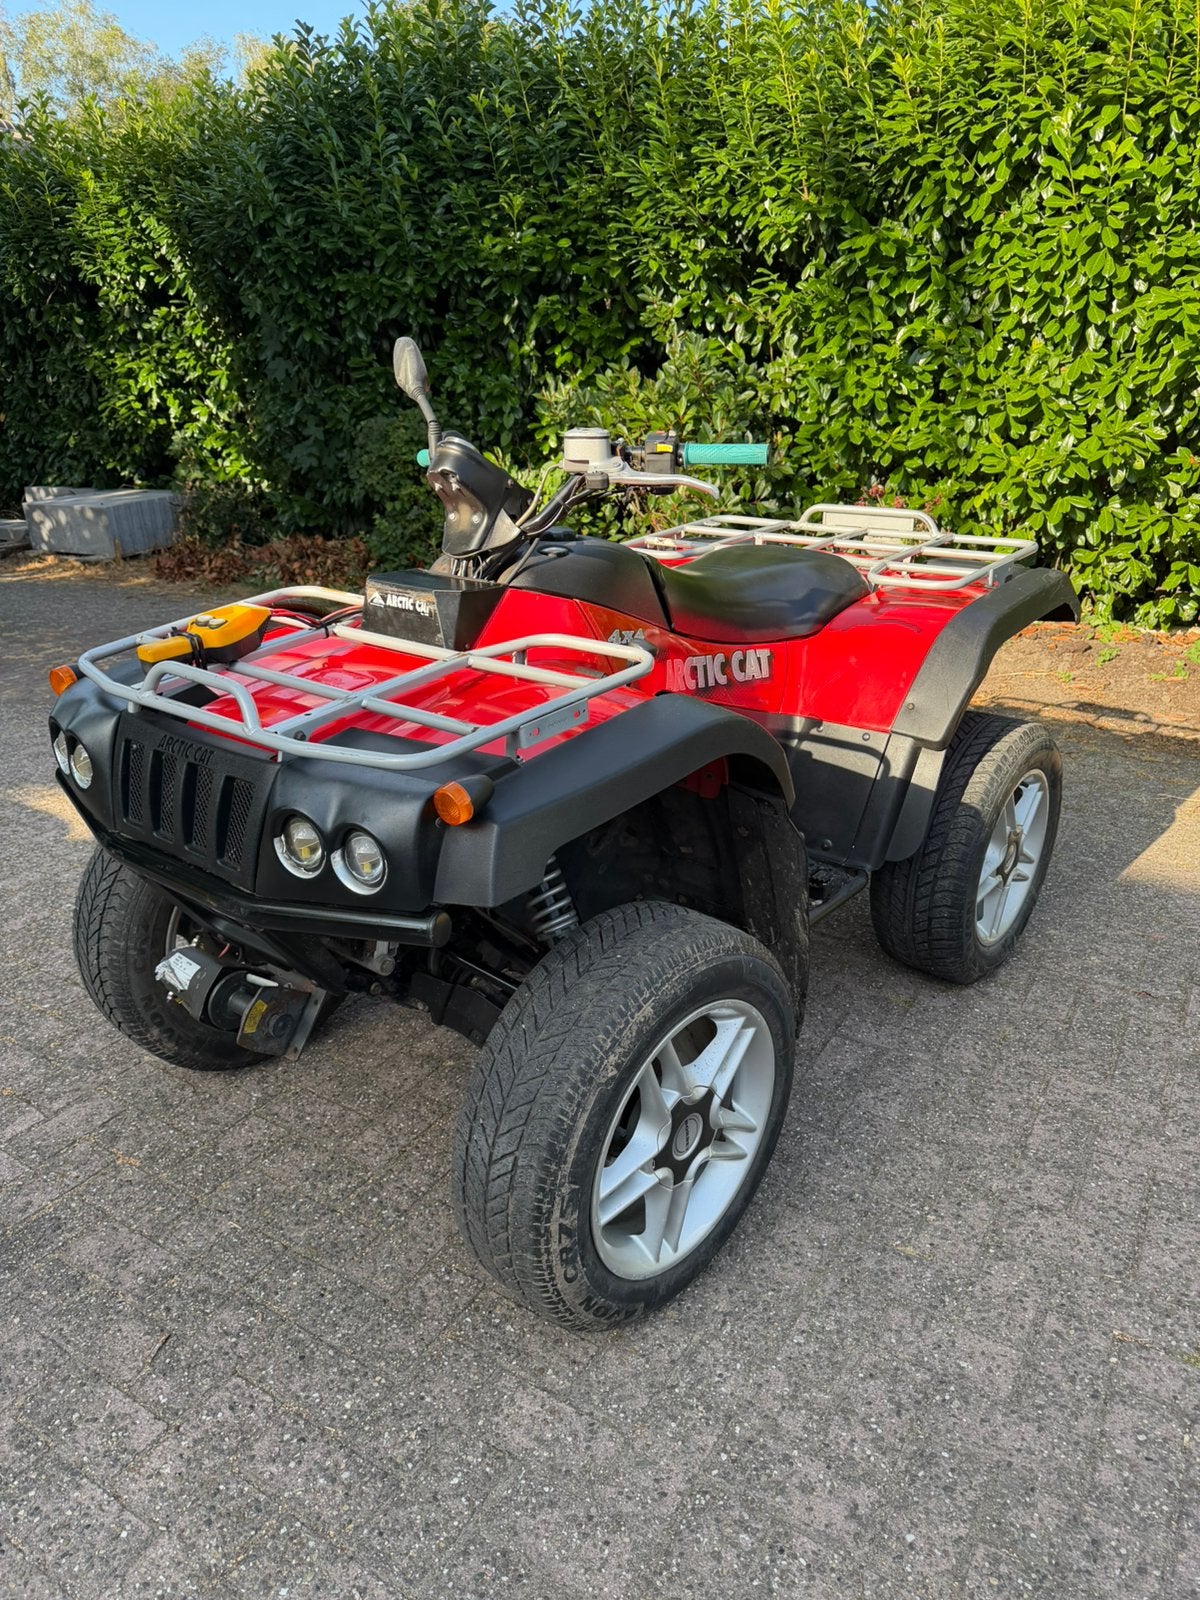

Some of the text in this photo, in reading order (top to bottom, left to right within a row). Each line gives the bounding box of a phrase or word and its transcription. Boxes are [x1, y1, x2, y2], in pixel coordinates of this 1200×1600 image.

[386, 593, 414, 611] ARCTIC
[666, 649, 771, 692] ARCTIC CAT
[158, 735, 214, 765] ARCTIC CAT
